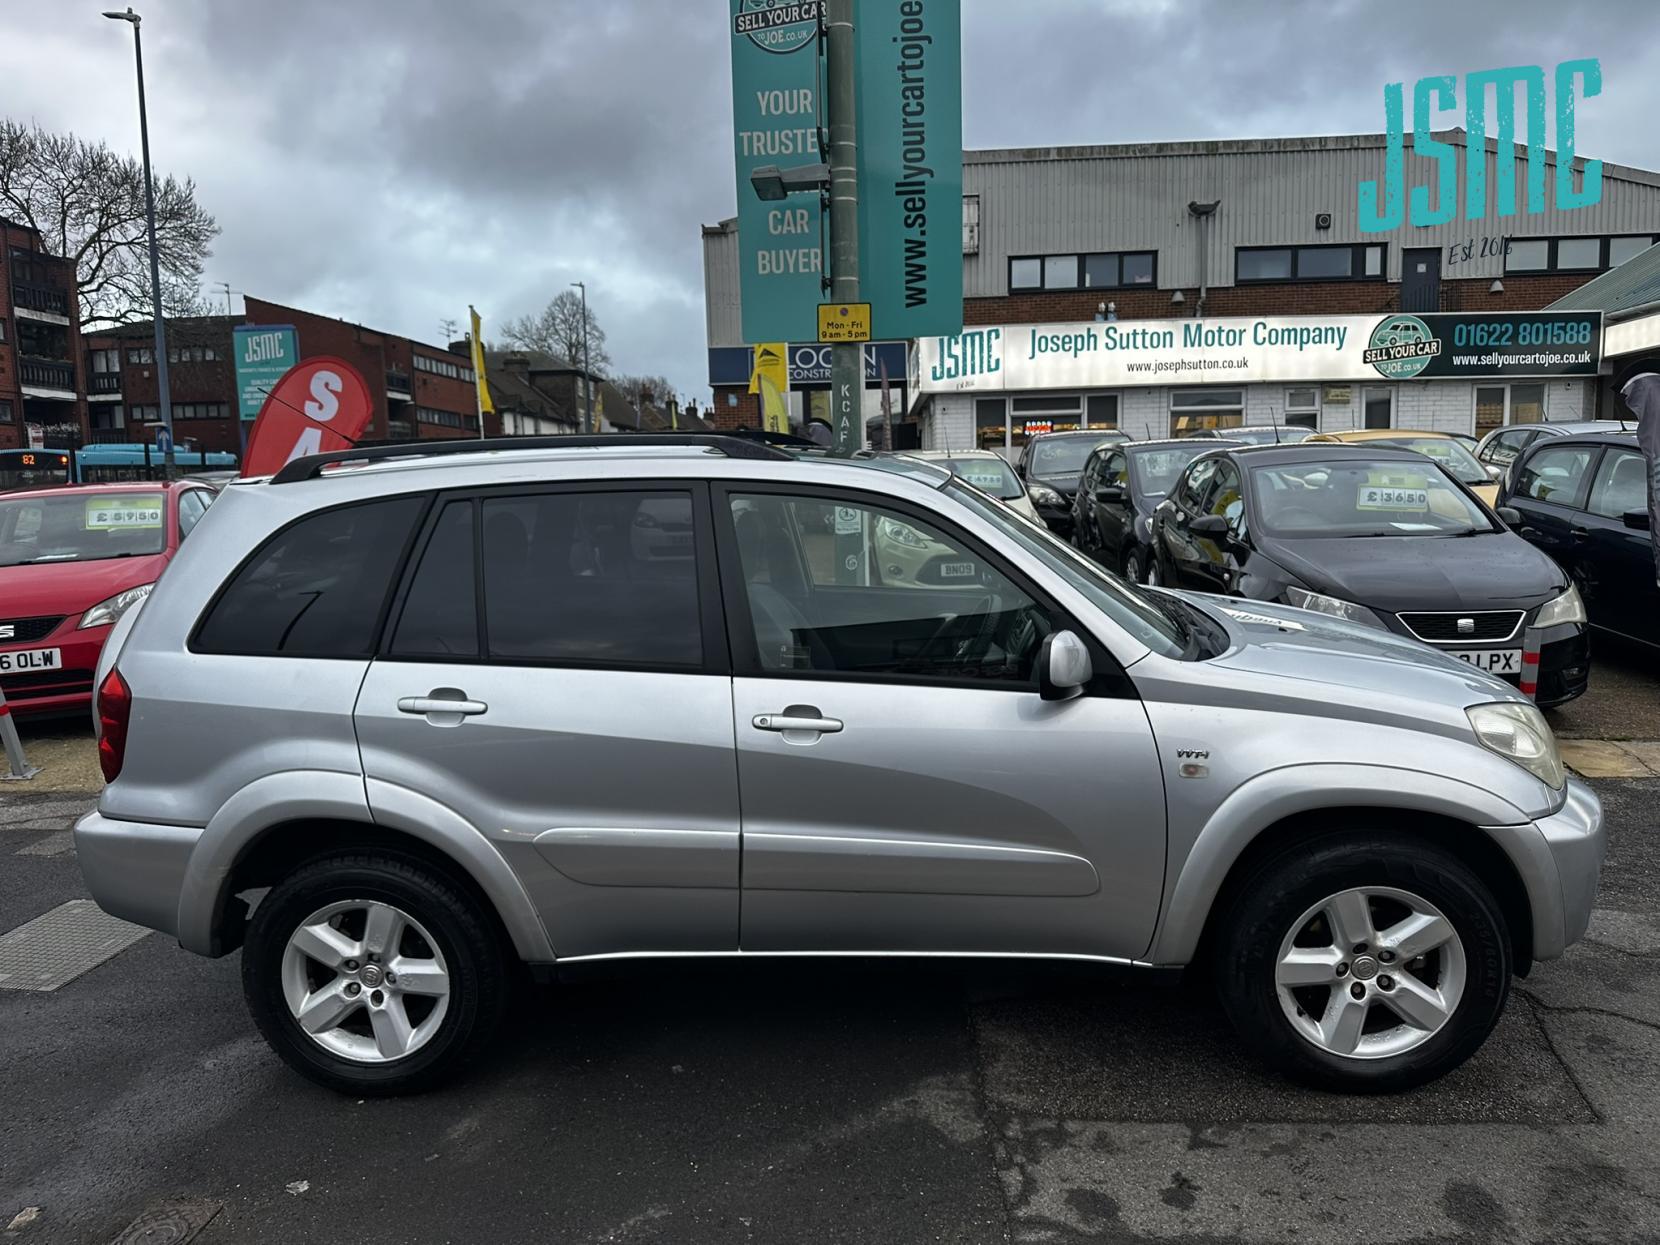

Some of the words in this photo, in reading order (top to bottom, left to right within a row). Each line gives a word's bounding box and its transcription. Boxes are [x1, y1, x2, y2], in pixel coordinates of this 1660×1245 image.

[737, 13, 766, 32] SELL
[766, 6, 800, 26] YOUR
[757, 88, 813, 116] YOUR
[768, 209, 809, 235] CAR
[757, 248, 822, 275] BUYER
[826, 321, 845, 329] Mon
[851, 321, 863, 329] Fri
[1454, 323, 1513, 347] 01622
[1518, 321, 1592, 346] 801588
[244, 332, 285, 363] JSMC
[1029, 327, 1098, 359] Joseph
[1104, 325, 1174, 350] Sutton
[1183, 322, 1247, 348] Motor
[1253, 322, 1348, 351] Company
[1365, 349, 1388, 362] SELL
[1389, 344, 1416, 359] YOUR
[1416, 341, 1438, 355] CAR
[931, 328, 1001, 381] JSMC
[1126, 357, 1249, 374] www.josephsutton.co.uk
[1452, 349, 1592, 368] www.sellyourcartojoe.co.uk
[22, 454, 35, 465] 82
[1367, 491, 1426, 503] £3650
[16, 650, 53, 668] OLW
[1476, 653, 1513, 671] LPX
